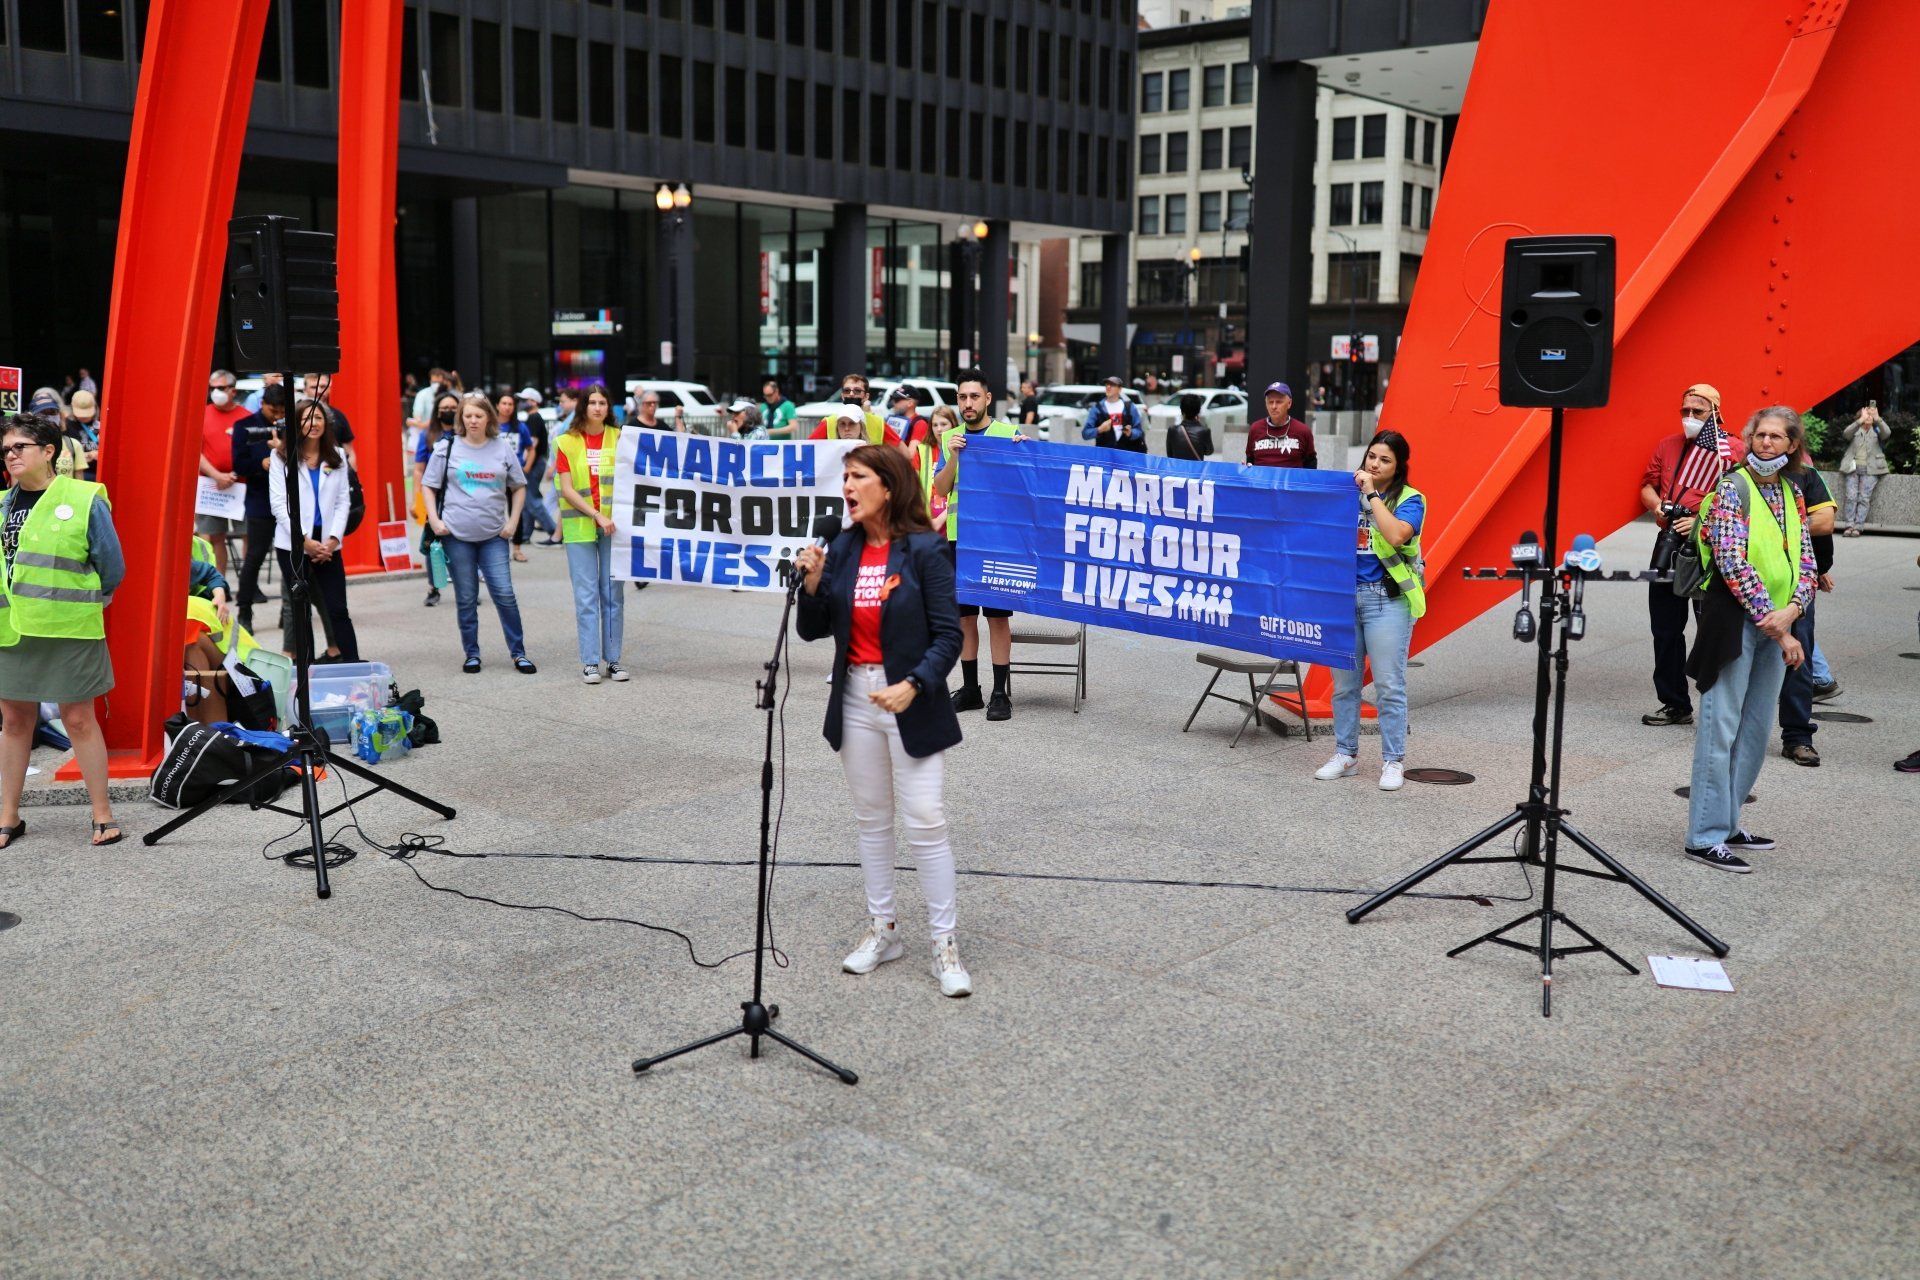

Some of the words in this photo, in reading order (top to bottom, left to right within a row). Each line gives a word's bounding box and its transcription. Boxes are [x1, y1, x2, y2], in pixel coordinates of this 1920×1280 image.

[560, 312, 586, 320] Jackson
[465, 471, 496, 479] Votes
[633, 432, 816, 488] MARCH
[632, 484, 733, 535] FOR
[1064, 463, 1216, 524] MARCH
[630, 535, 772, 588] LIVES
[1064, 512, 1146, 565] FOR
[1150, 524, 1242, 579] OUR
[1512, 545, 1537, 558] WGN
[981, 575, 1037, 590] EVERYTOWN
[1062, 560, 1179, 619] LIVES
[1260, 615, 1322, 640] GIFFORDS
